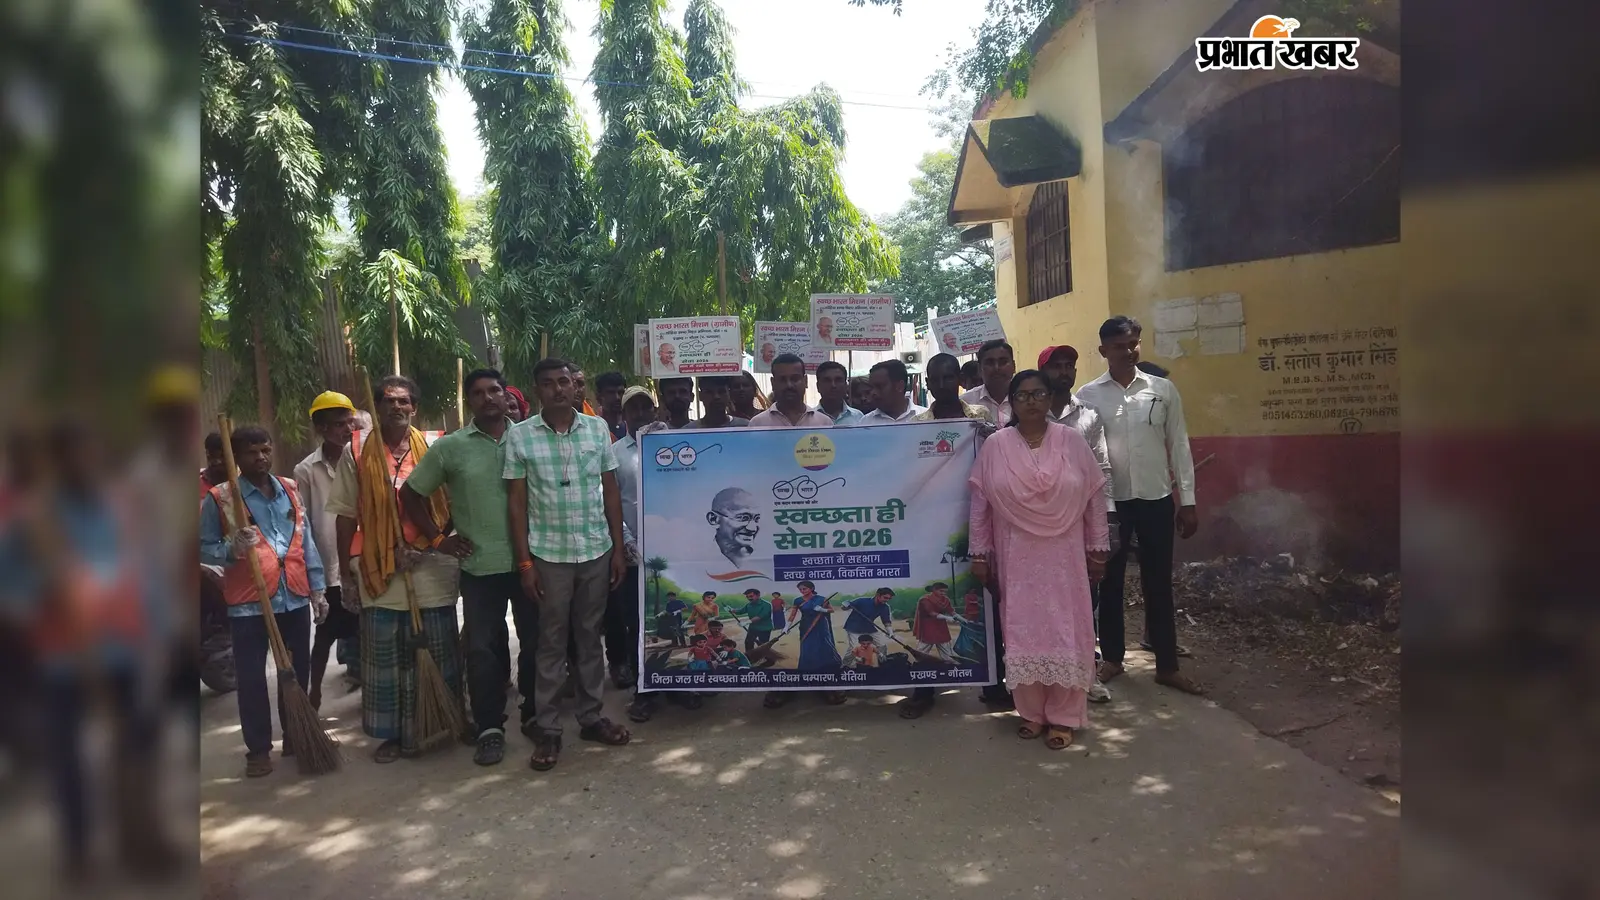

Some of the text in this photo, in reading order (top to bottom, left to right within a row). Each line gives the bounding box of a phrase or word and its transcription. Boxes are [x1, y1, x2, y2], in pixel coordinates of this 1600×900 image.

[867, 297, 892, 306] (ग्रामीण)
[690, 320, 709, 328] मिशन
[711, 320, 737, 329] (ग्रामीण)
[1258, 343, 1398, 373] डॉ. संतोष कुमार सिंह
[773, 498, 907, 525] स्वच्छता ही
[773, 526, 893, 550] सेवा 2026
[802, 553, 880, 566] स्वच्छता में सहभाग
[783, 567, 900, 580] स्वच्छ भारत, विकसित भारत
[651, 672, 673, 684] जिला
[674, 675, 692, 684] जल
[693, 672, 706, 684] एवं
[707, 674, 738, 684] स्वच्छता
[740, 671, 770, 683] समिति,
[802, 673, 838, 683] चम्पारण,
[841, 670, 867, 681] बेतिया
[909, 669, 937, 680] प्रखण्ड
[948, 666, 973, 678] नौतन
